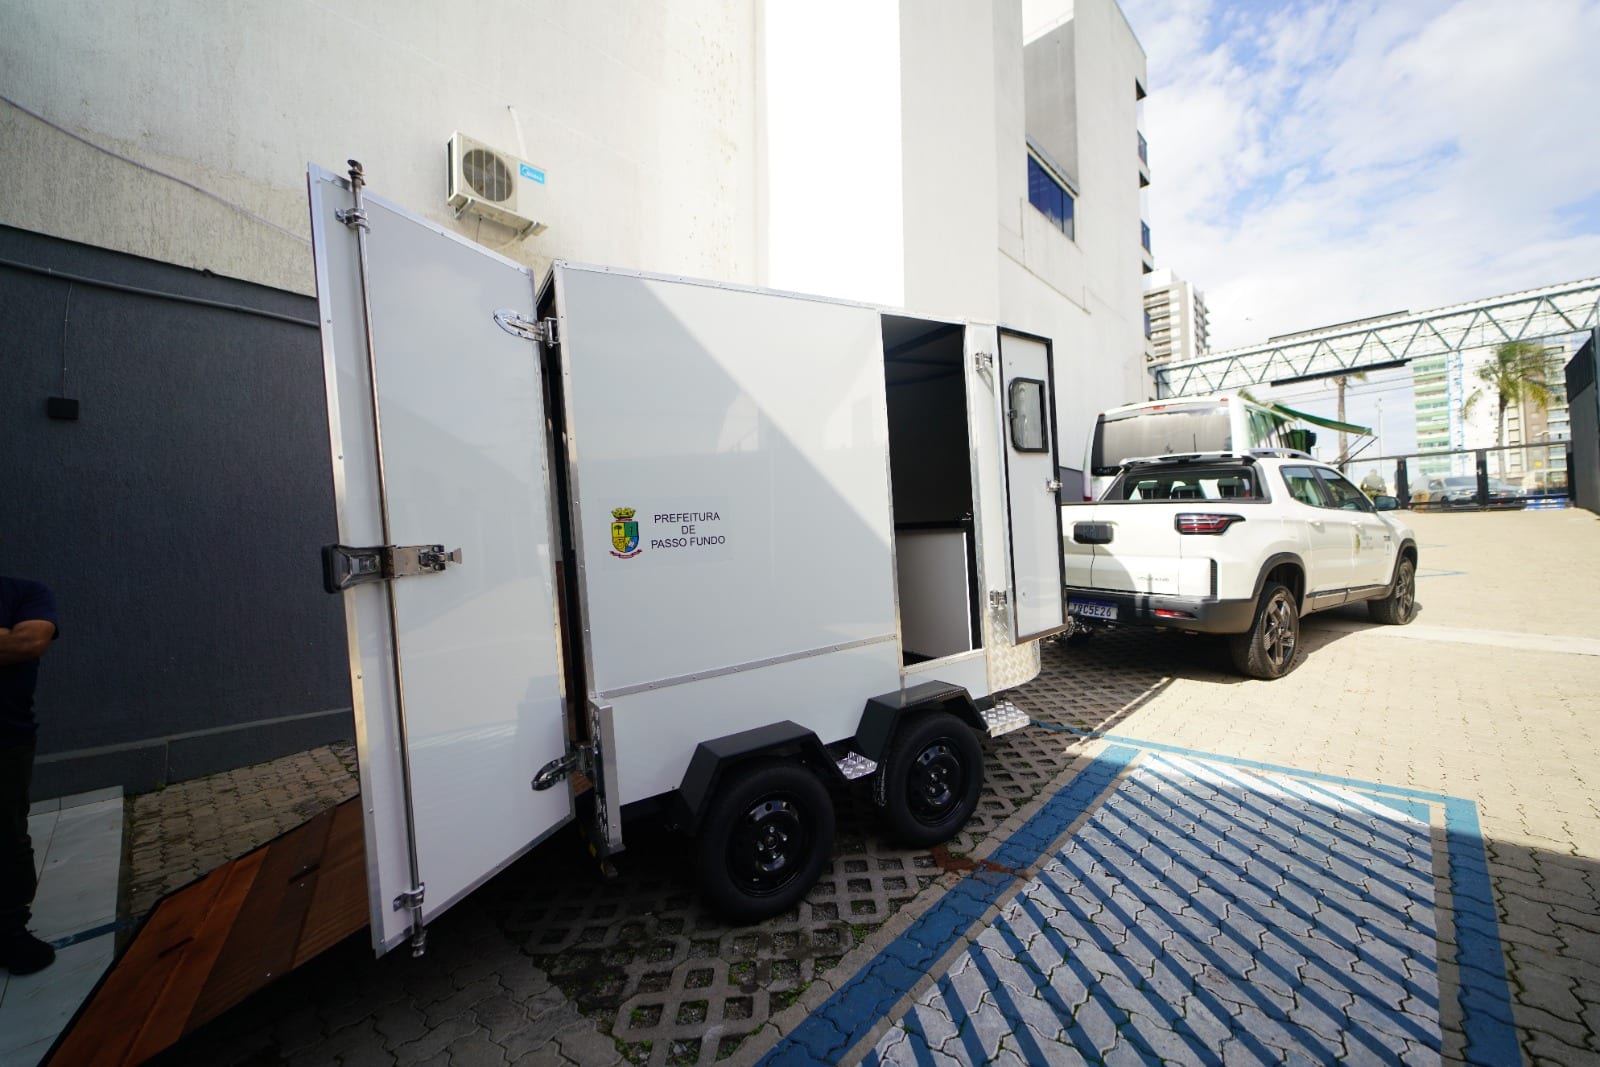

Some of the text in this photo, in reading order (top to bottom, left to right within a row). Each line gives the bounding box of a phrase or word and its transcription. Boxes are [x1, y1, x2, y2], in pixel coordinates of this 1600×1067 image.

[654, 512, 720, 523] PREFEITURA
[681, 525, 696, 535] DE
[651, 536, 725, 549] PASSO FUNDO
